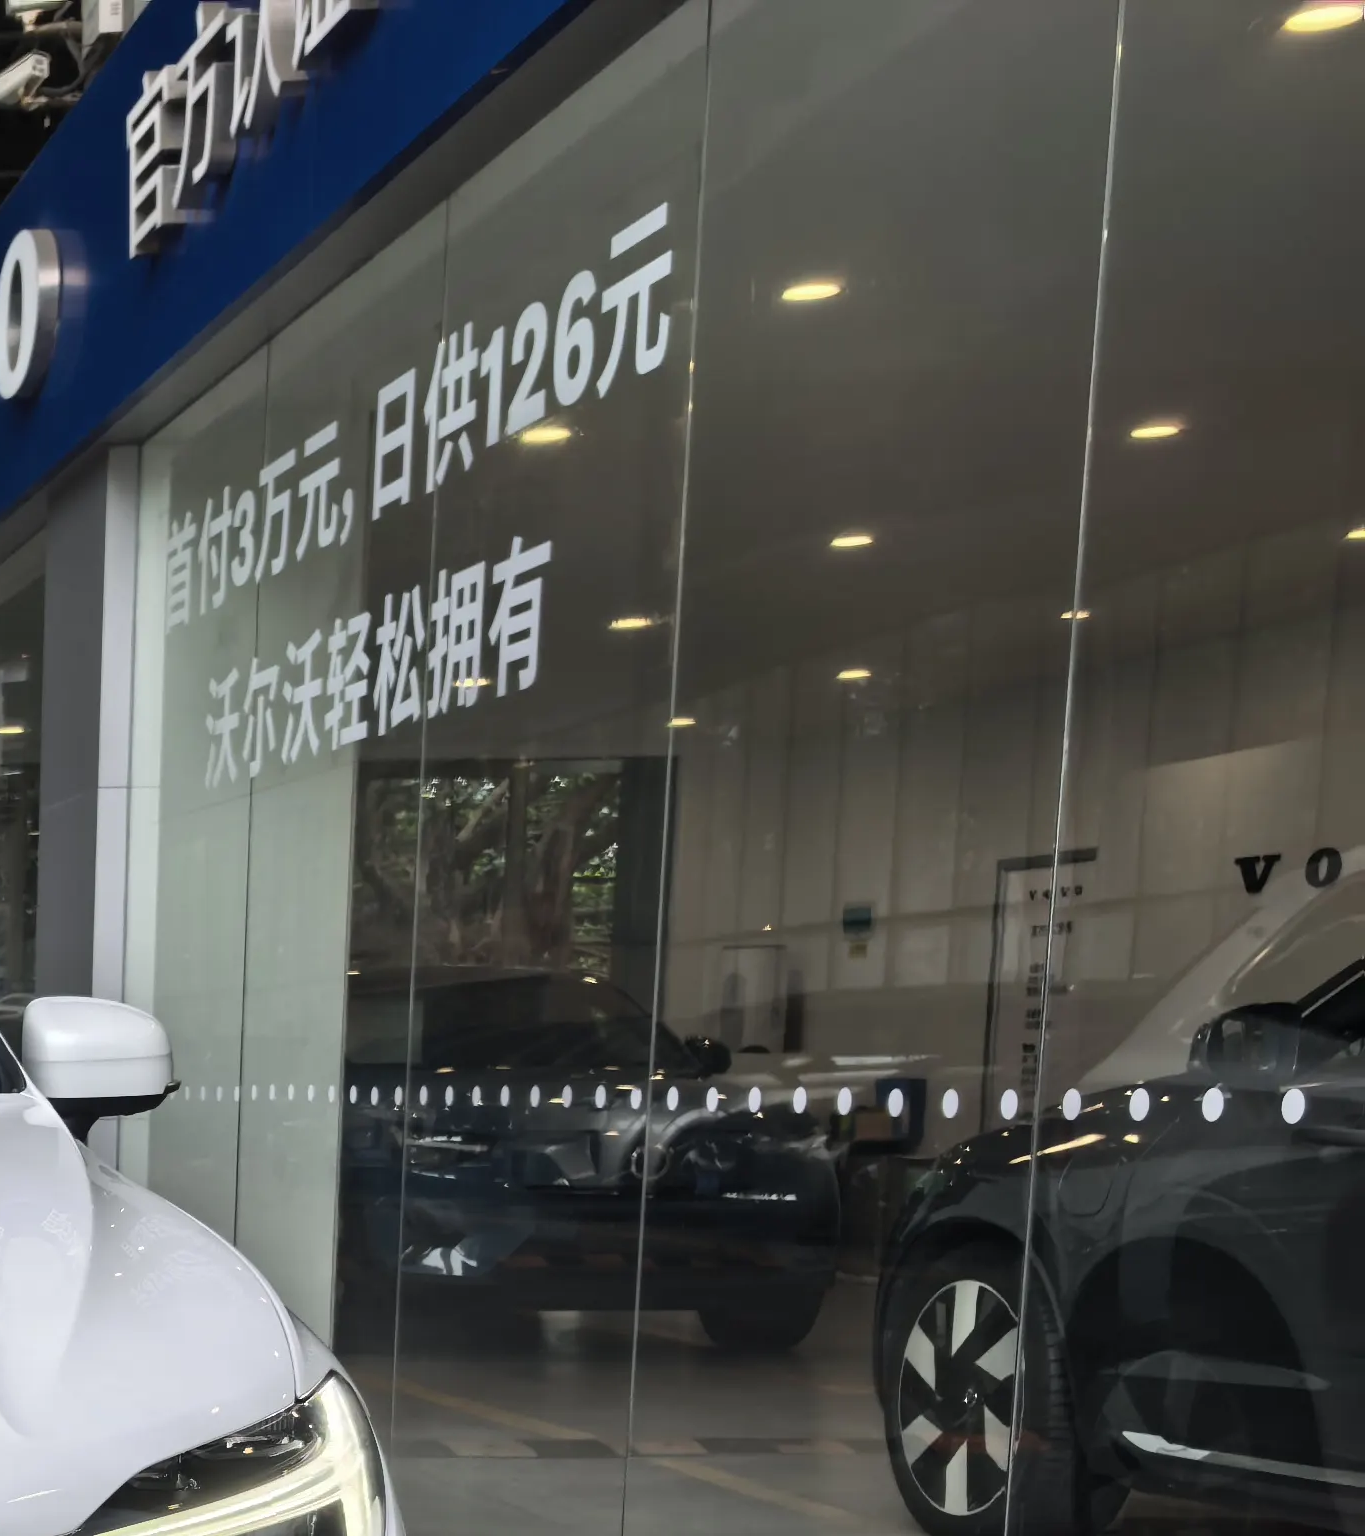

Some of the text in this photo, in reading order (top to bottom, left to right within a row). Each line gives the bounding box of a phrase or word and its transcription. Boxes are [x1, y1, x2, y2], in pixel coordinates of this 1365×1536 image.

[205, 536, 553, 789] 沃尔沃轻松拥有
